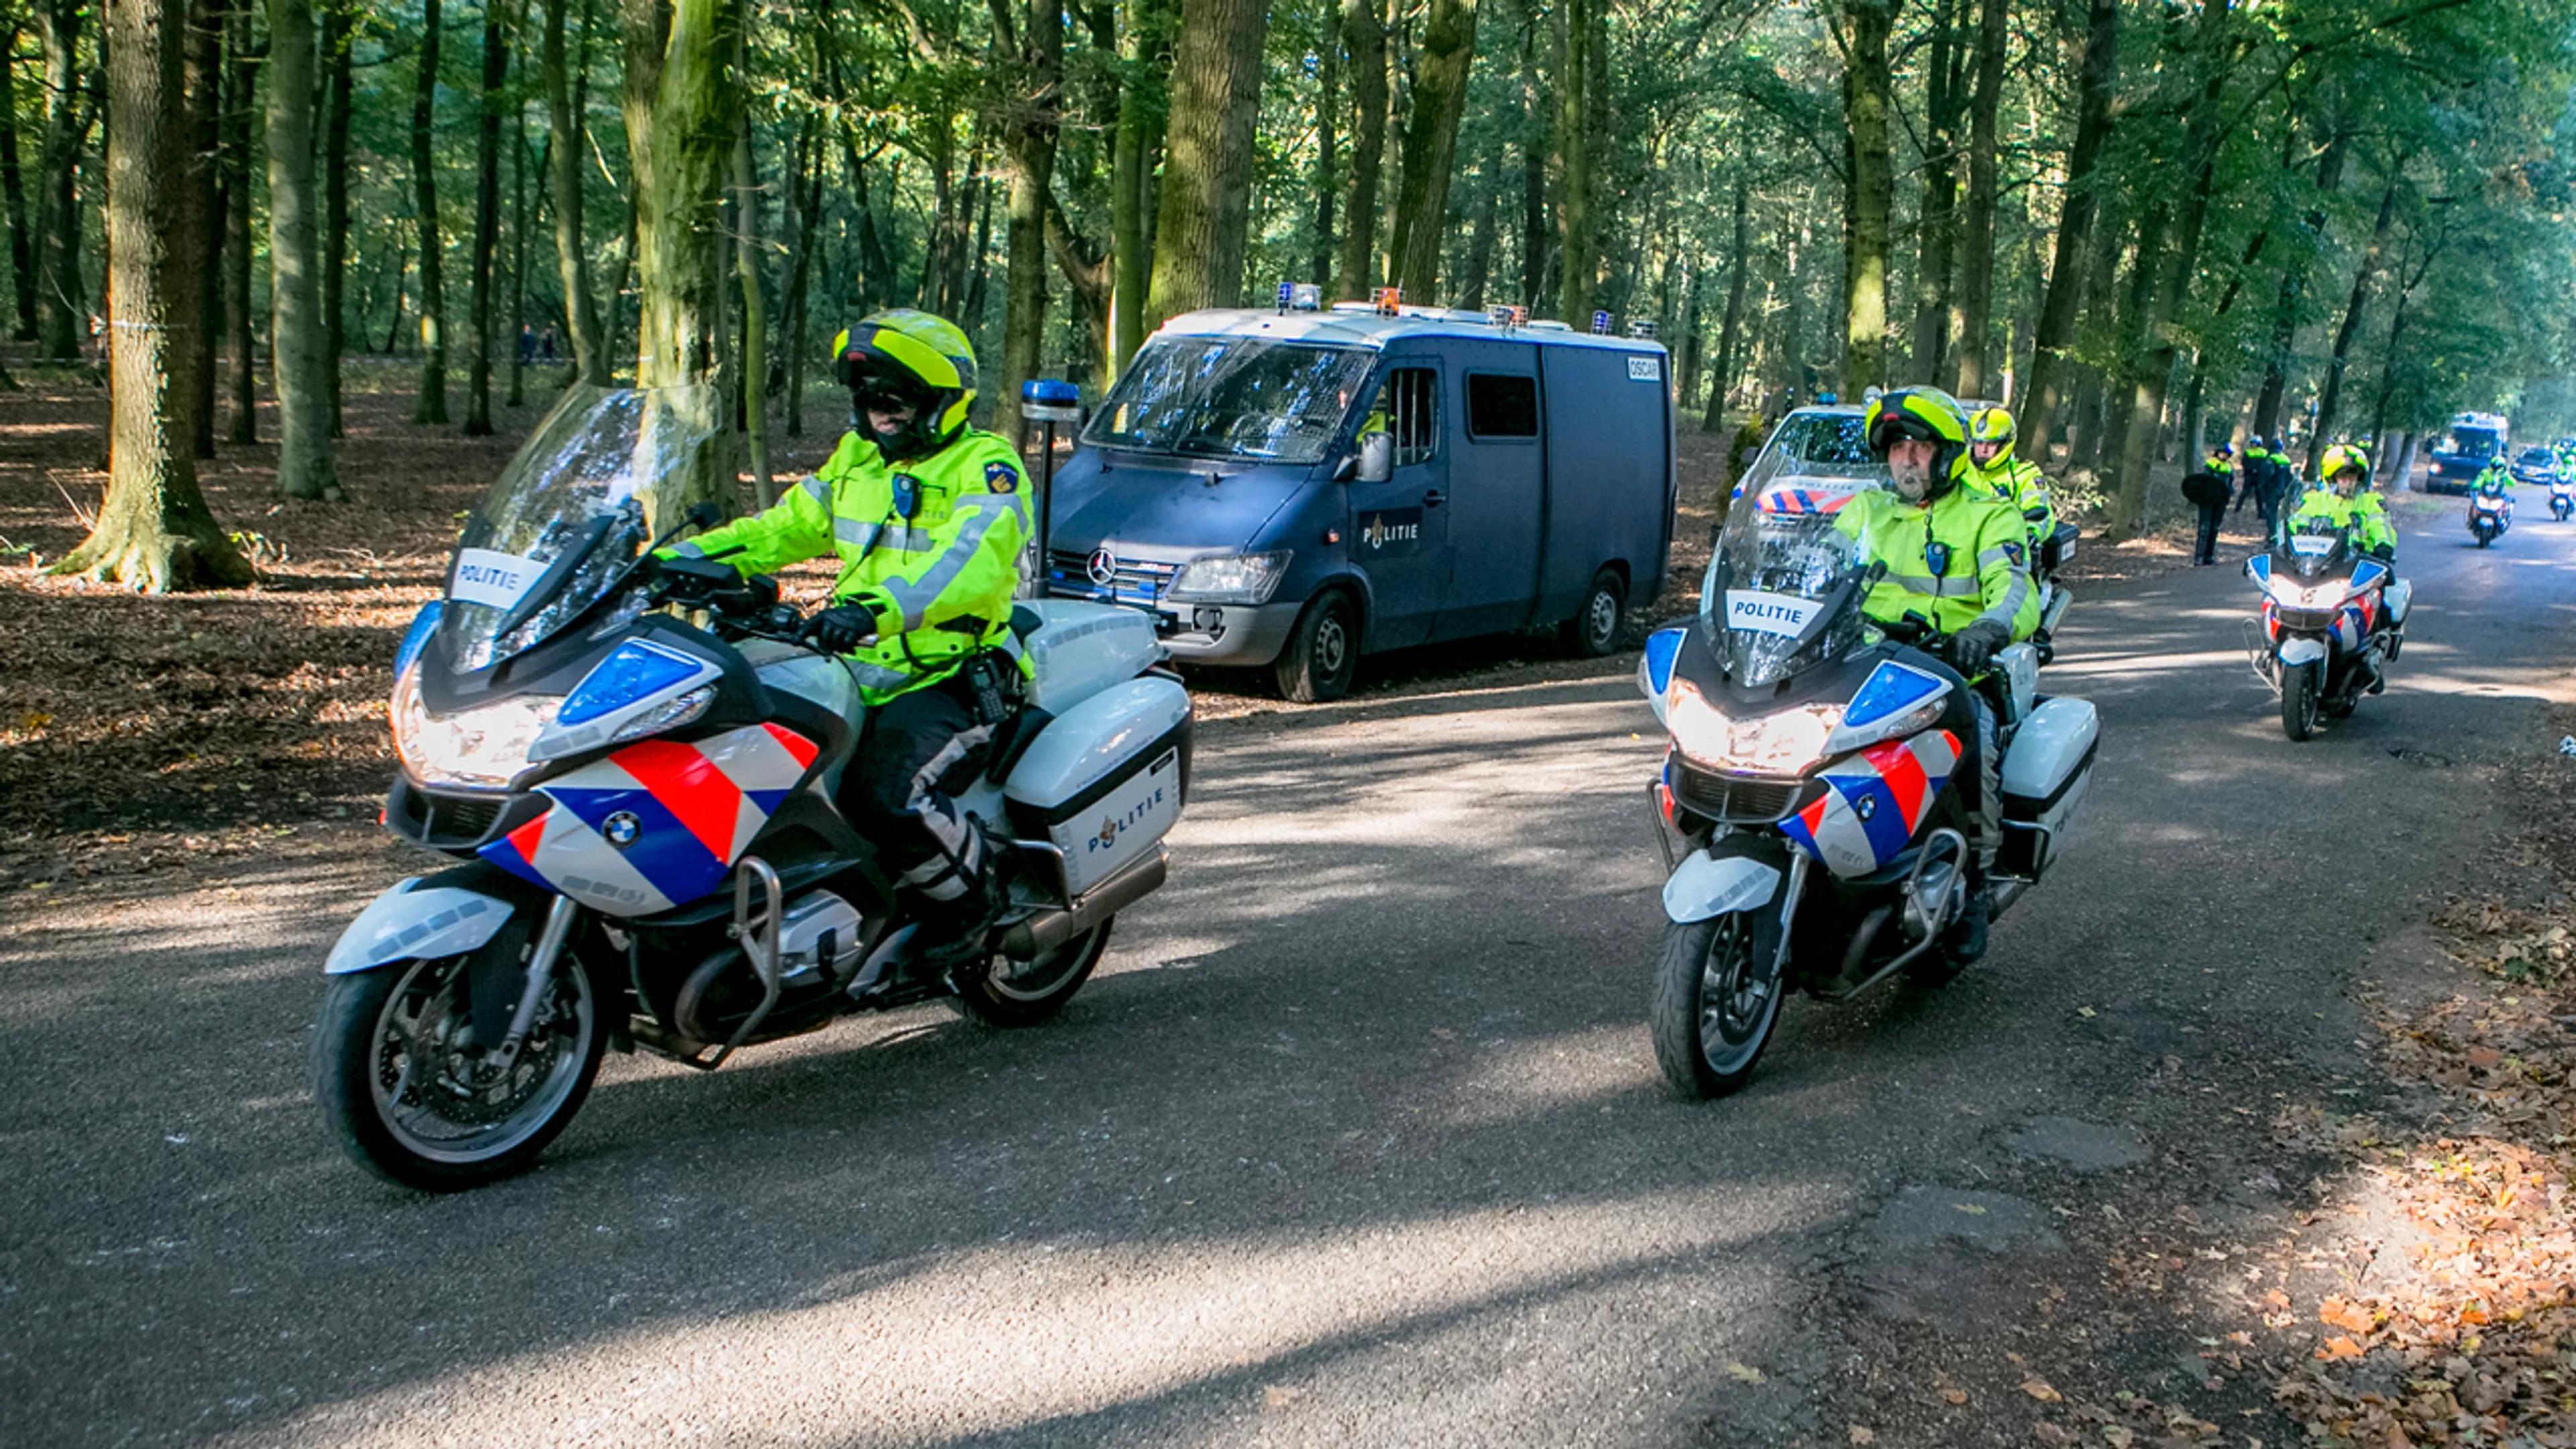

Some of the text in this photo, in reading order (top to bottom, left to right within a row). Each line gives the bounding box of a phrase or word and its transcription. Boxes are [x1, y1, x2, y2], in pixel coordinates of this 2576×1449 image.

[1630, 360, 1658, 377] OSCAR
[1363, 523, 1418, 549] POLITIE
[460, 565, 519, 590] POLITIE
[1735, 601, 1803, 625] POLITIE
[1088, 787, 1164, 853] POLITIE
